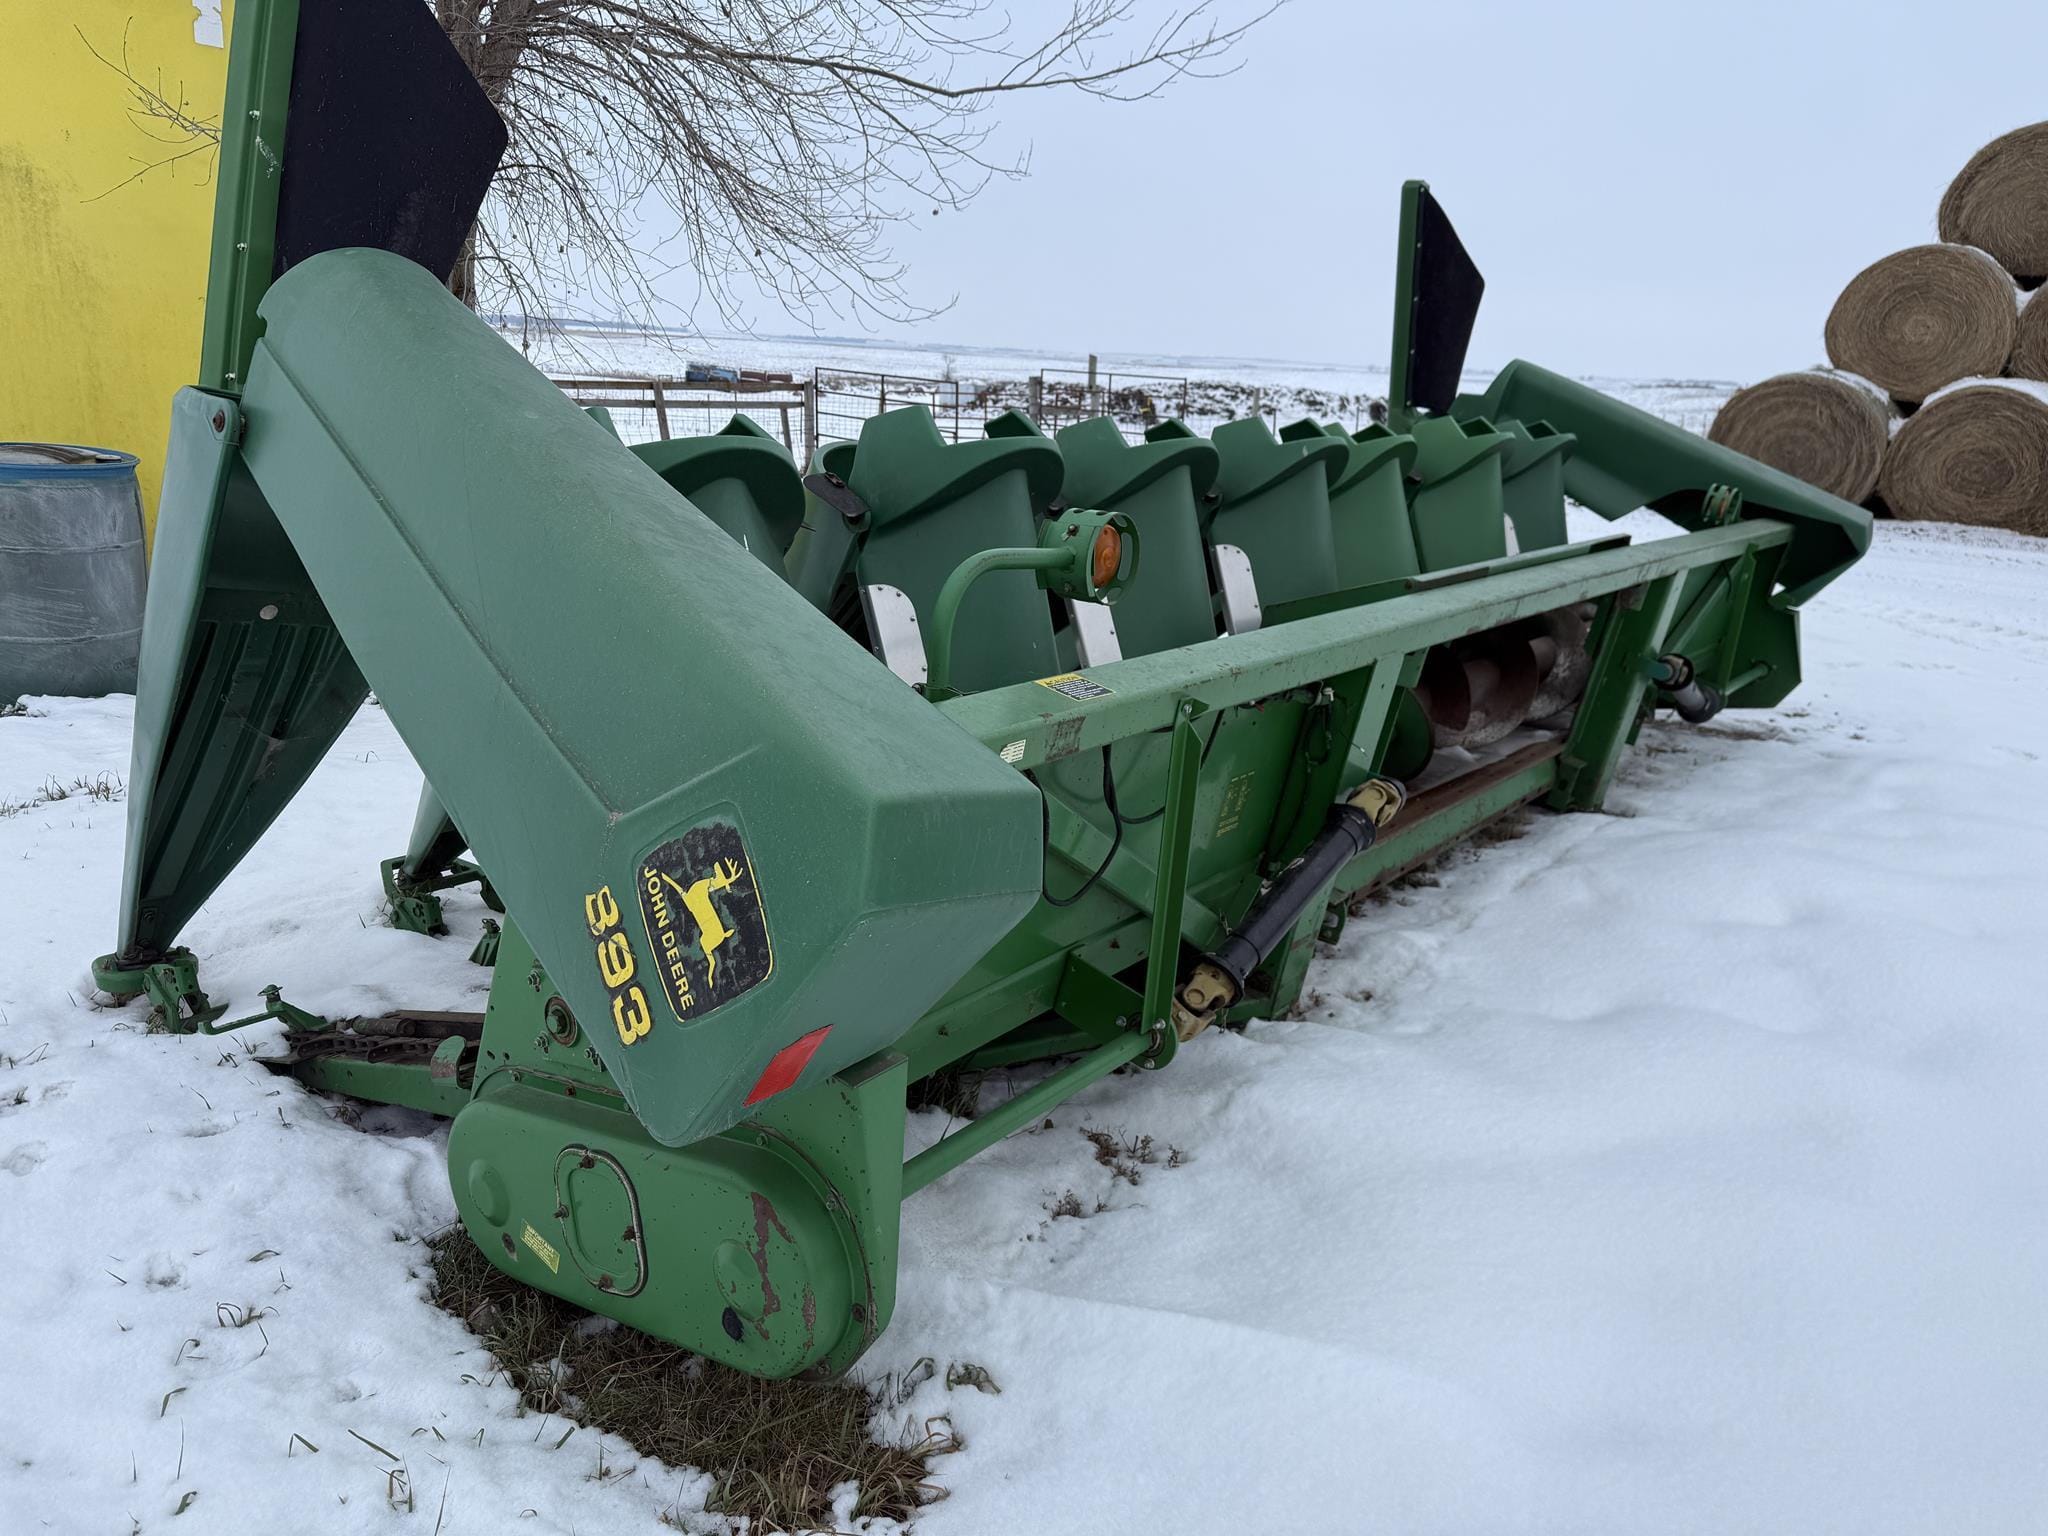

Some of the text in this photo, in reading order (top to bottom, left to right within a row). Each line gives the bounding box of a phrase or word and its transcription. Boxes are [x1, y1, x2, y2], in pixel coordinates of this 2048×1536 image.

[585, 885, 651, 1046] 893
[643, 866, 695, 1011] JOHN DEERE
